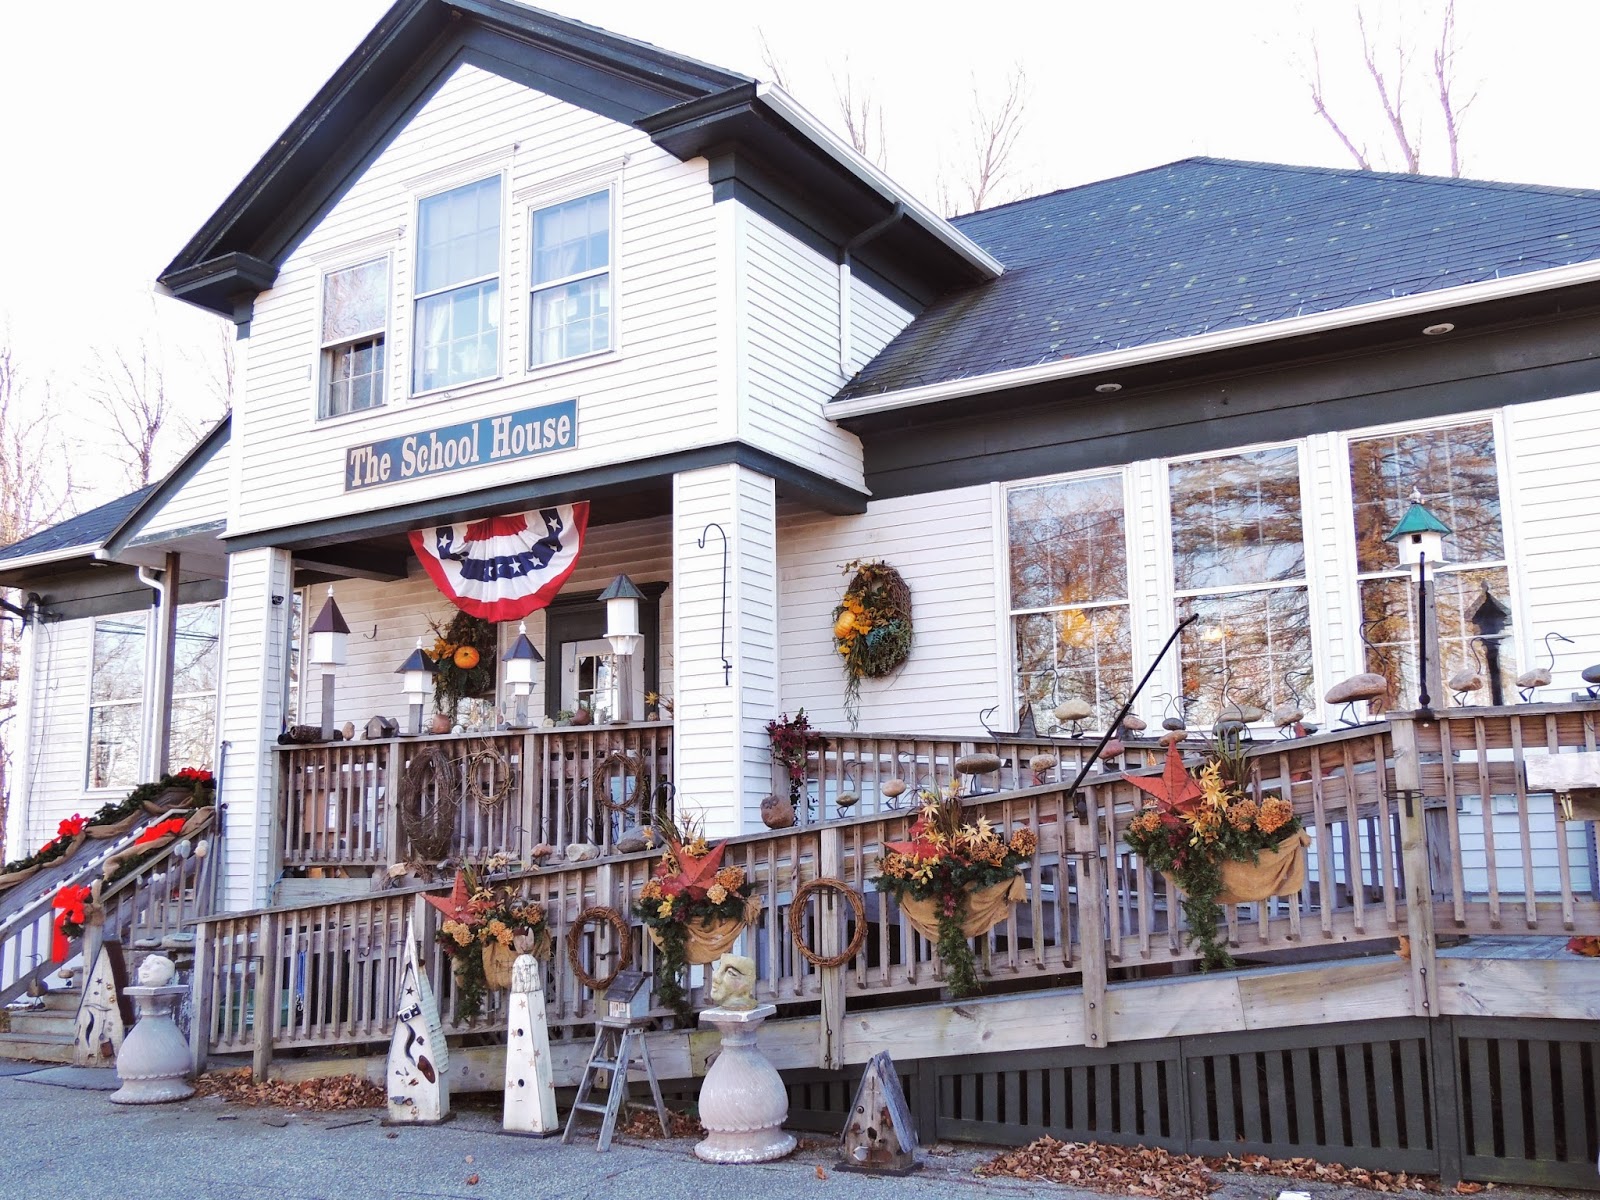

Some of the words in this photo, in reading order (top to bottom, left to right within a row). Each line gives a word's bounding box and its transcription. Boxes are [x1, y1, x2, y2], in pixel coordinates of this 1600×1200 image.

[350, 446, 391, 487] The
[400, 422, 480, 477] School
[490, 414, 571, 459] House
